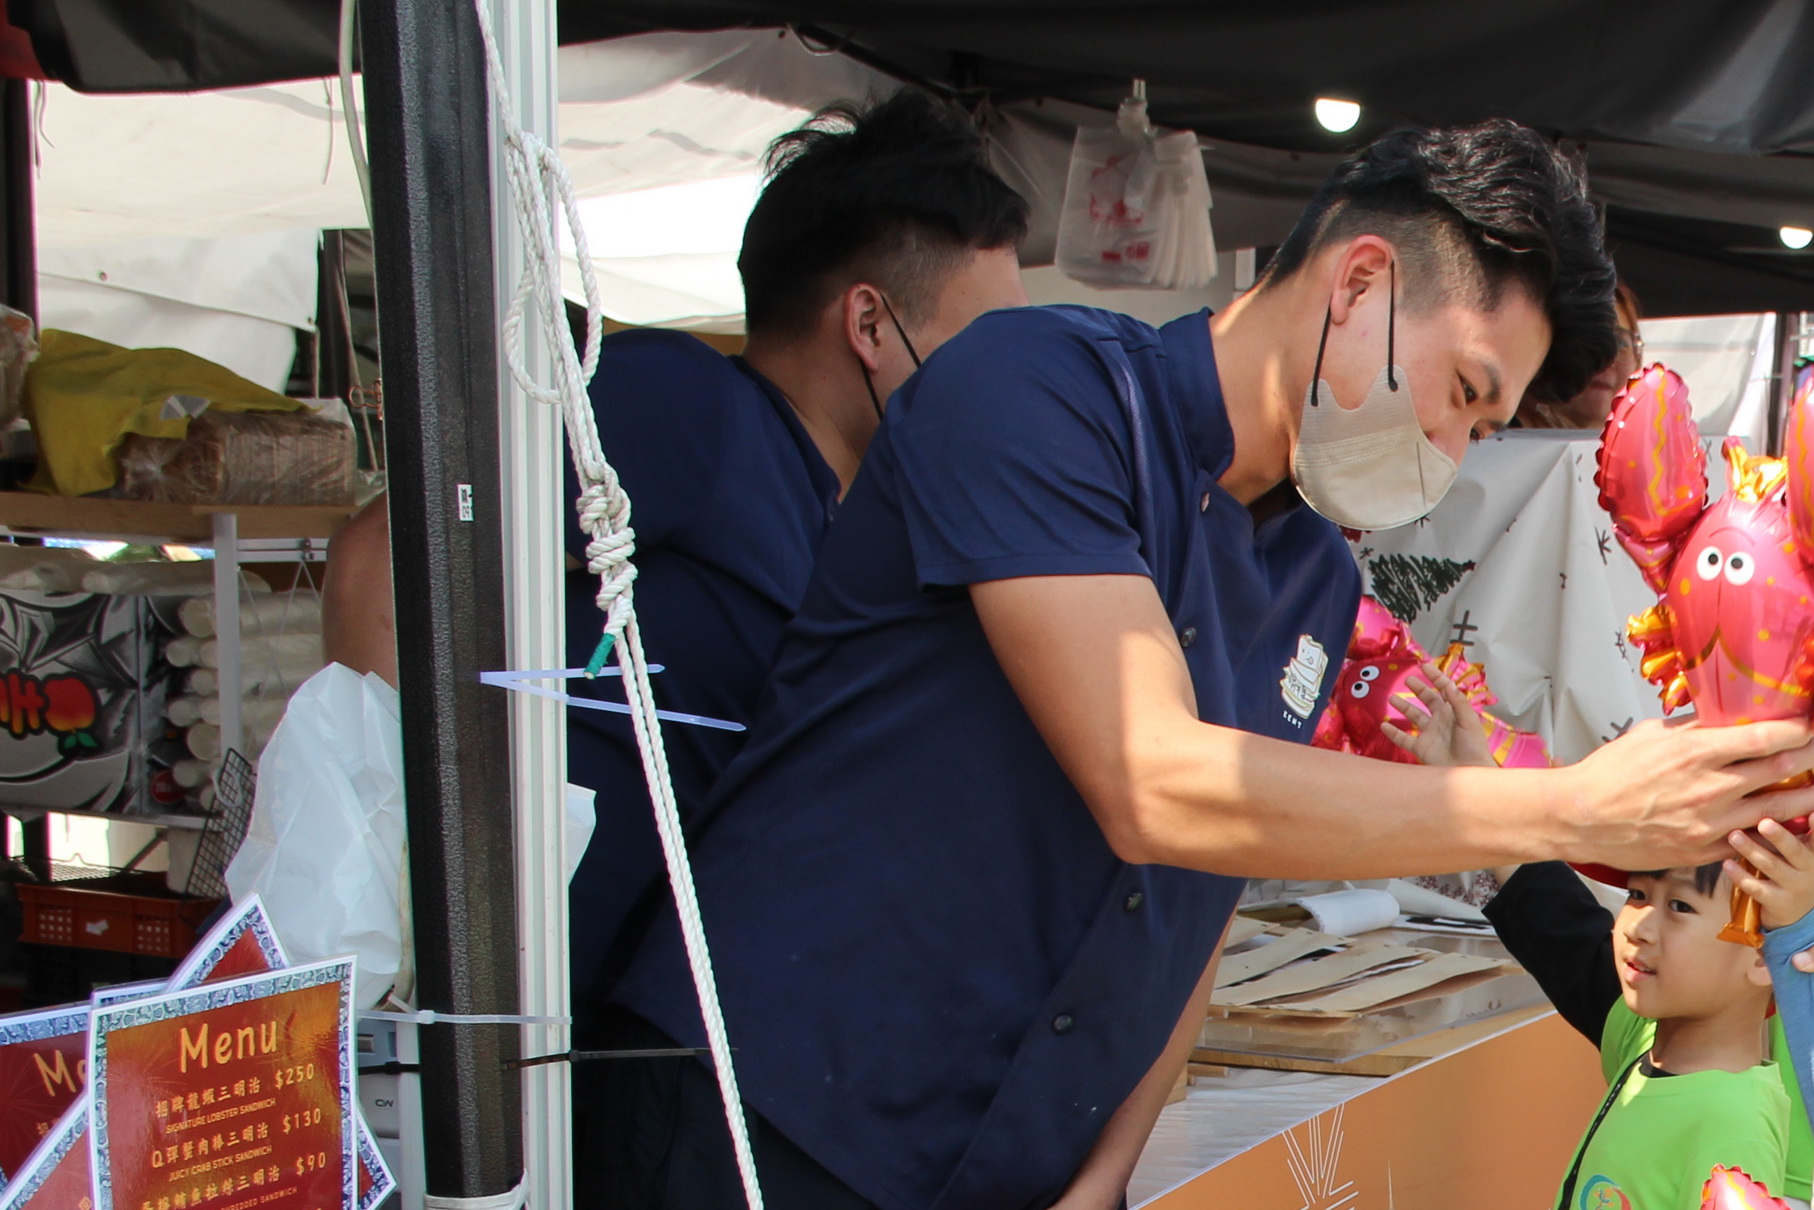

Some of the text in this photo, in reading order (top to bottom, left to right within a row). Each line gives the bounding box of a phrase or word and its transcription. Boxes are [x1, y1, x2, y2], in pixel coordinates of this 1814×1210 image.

[180, 1021, 278, 1073] Menu
[275, 1063, 315, 1090] $250
[166, 1098, 276, 1134] SIGNATURE LOBSTER SANDWICH
[283, 1108, 322, 1134] $130
[169, 1145, 273, 1182] JUICY CRAB STICK SANDWICH
[296, 1152, 326, 1176] $90
[260, 1186, 298, 1204] SANDWICH
